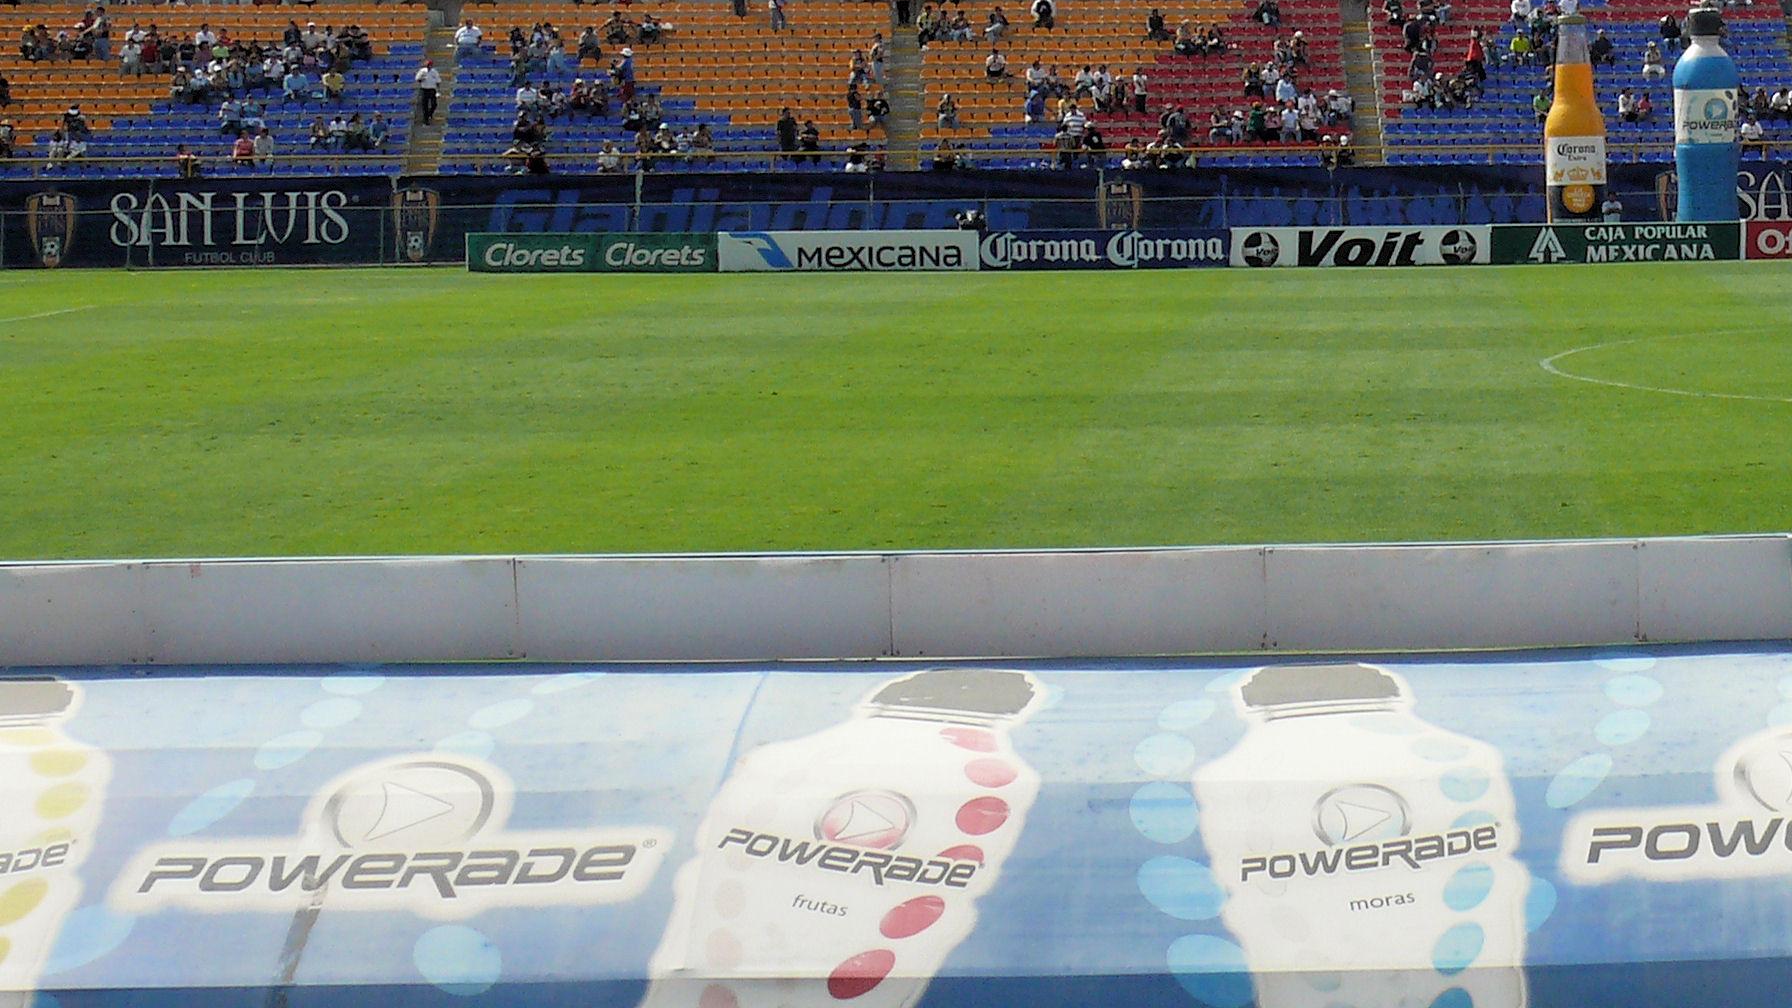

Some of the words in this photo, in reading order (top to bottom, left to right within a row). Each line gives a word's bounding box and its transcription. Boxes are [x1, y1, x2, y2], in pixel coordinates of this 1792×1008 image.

[1557, 143, 1596, 156] Corona
[109, 191, 217, 247] SAN
[231, 190, 350, 245] LUIS
[1584, 226, 1623, 241] CAJA
[1634, 226, 1709, 240] POPULAR
[484, 242, 585, 267] Clorets
[604, 241, 706, 266] Clorets
[980, 231, 1100, 269] Corona
[1106, 230, 1225, 269] Corona
[1297, 229, 1426, 266] Voit
[1586, 244, 1716, 262] MEXICANA
[791, 894, 850, 918] frutas
[1350, 892, 1417, 913] moras
